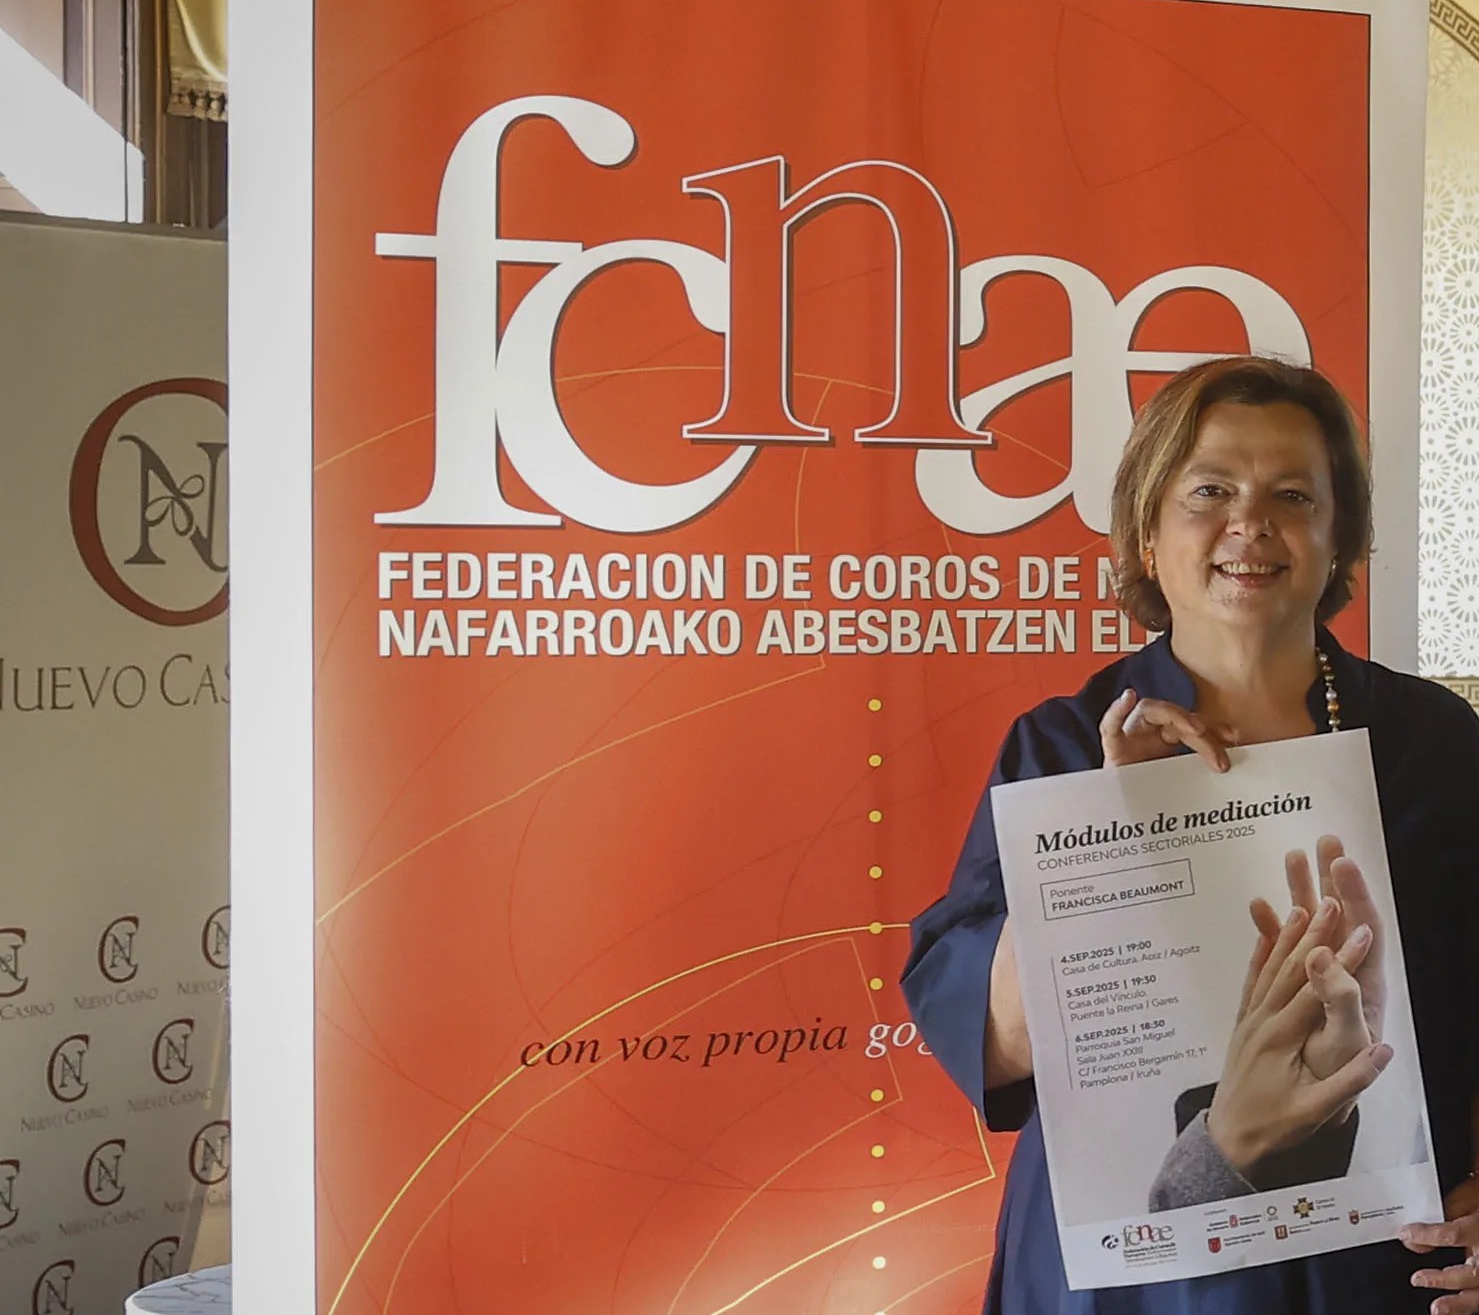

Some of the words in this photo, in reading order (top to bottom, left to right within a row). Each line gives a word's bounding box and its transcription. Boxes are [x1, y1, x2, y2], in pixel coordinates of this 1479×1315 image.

[377, 551, 725, 600] FEDERACION
[744, 555, 812, 600] DE
[830, 555, 1001, 601] COROS
[1019, 557, 1081, 600] DE
[379, 610, 741, 657] NAFARROAKO
[757, 610, 1074, 655] ABESBATZEN
[1035, 821, 1145, 854] Módulos
[1151, 813, 1177, 835] de
[1185, 793, 1312, 829] mediación
[1037, 845, 1138, 871] CONFERENCIAS
[1141, 831, 1223, 854] SECTORIALES
[1226, 825, 1255, 839] 2025
[1050, 885, 1094, 899] Ponente
[1052, 892, 1118, 912] FRANCISCA
[1120, 881, 1184, 901] BEAUMONT
[520, 1038, 600, 1067] con
[619, 1034, 690, 1062] voz
[702, 1017, 848, 1067] propia
